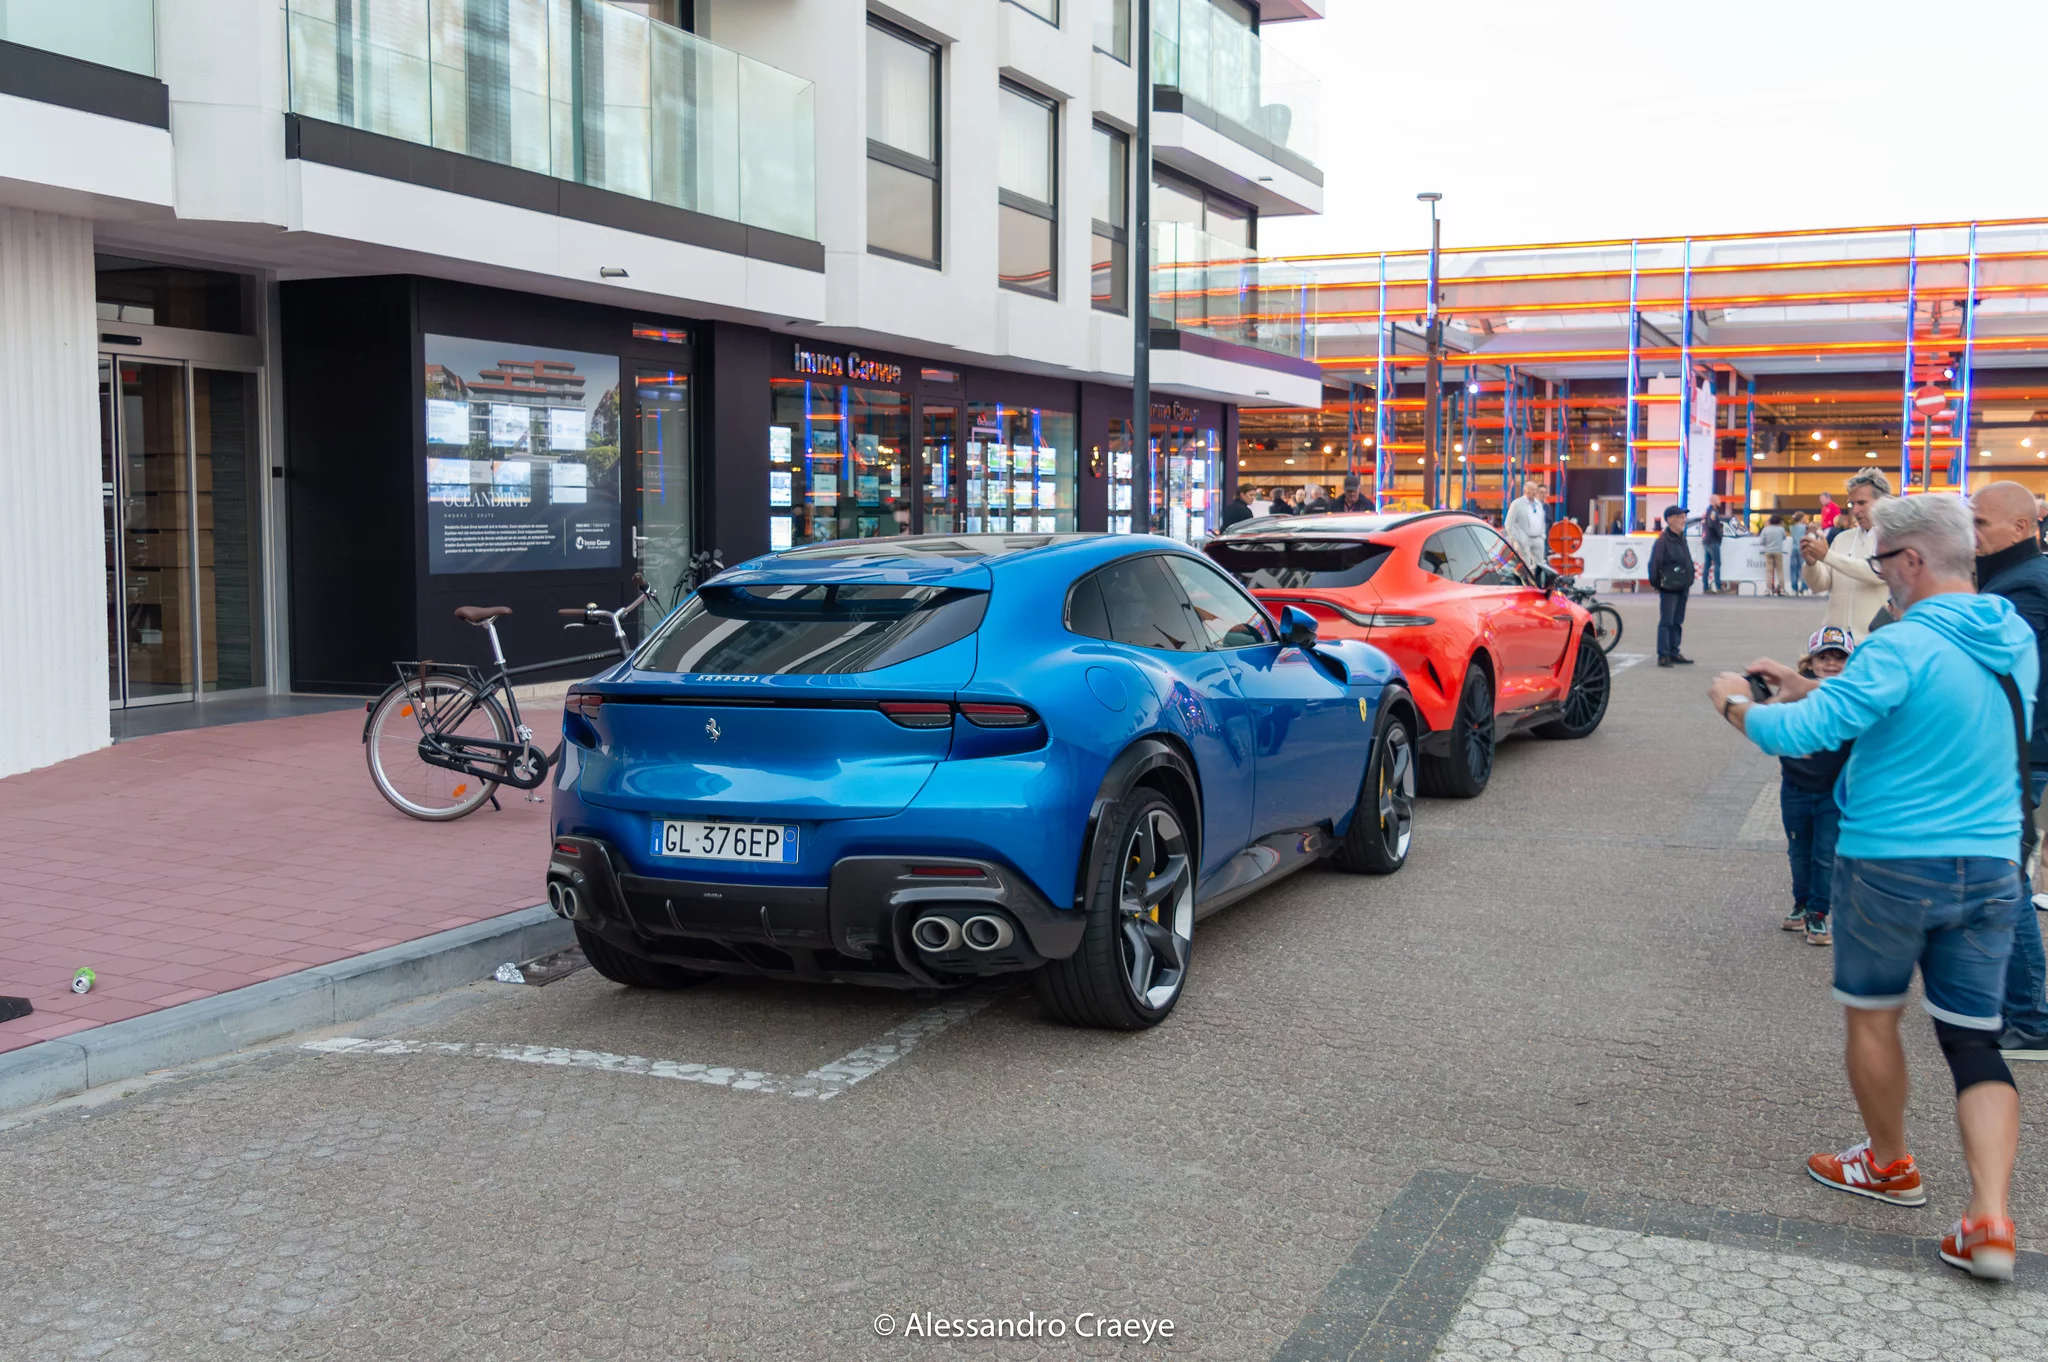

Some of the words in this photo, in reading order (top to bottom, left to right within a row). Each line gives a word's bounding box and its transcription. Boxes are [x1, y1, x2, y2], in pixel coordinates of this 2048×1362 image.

[794, 343, 843, 377] Immo
[848, 351, 902, 384] Cauwe
[1150, 403, 1171, 420] mmo
[443, 491, 528, 508] OCEANDRIVE
[665, 823, 691, 854] GL
[702, 825, 780, 858] 376EP
[1841, 1162, 1867, 1185] N
